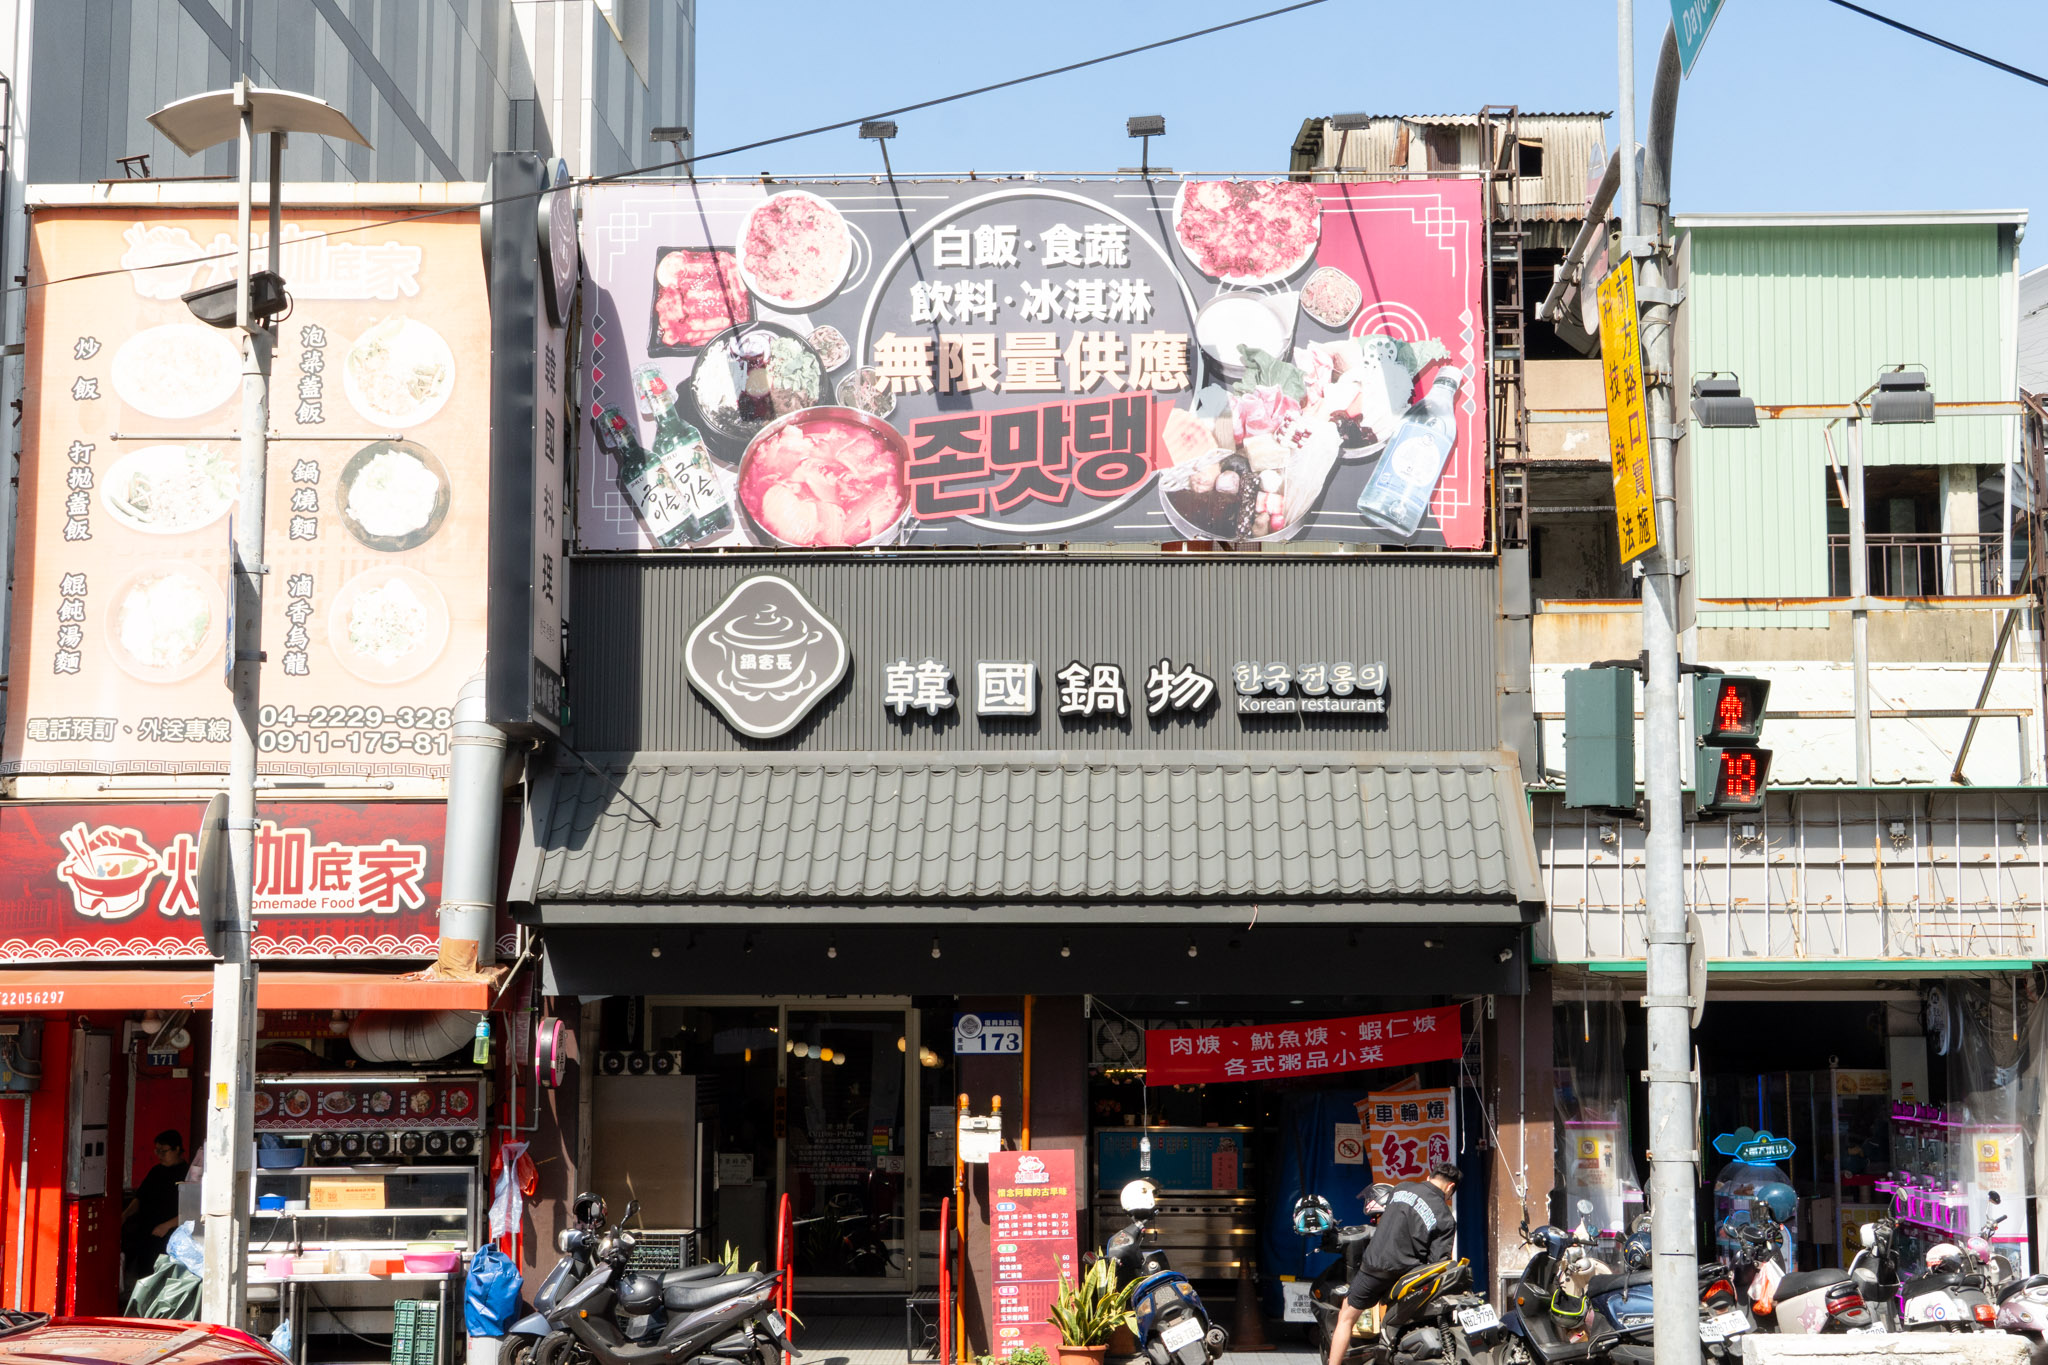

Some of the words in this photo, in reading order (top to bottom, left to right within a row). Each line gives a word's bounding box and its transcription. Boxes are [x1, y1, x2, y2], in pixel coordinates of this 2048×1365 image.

[910, 279, 1152, 322] 飲料·冰淇淋
[71, 336, 102, 401] 炒飯
[295, 324, 326, 424] 泡菜蓋飯
[873, 330, 1190, 393] 無限量供應
[1602, 283, 1635, 554] 科技執法
[1616, 271, 1651, 546] 前方路口實施
[904, 390, 1152, 520] 존맛탱
[289, 459, 320, 541] 鍋燒麵
[53, 572, 88, 675] 餛飩湯麵
[884, 657, 1217, 718] 韓國鍋物
[1234, 662, 1294, 694] 한국
[258, 705, 456, 730] 04-2229-328
[1239, 697, 1294, 712] Korean
[1301, 697, 1385, 713] restaurant
[258, 729, 454, 755] 0911-175-81
[251, 897, 317, 909] omemade
[321, 897, 355, 909] Food
[153, 1054, 174, 1066] 171
[977, 1033, 1020, 1051] 173
[1223, 1045, 1384, 1077] 各式粥品小菜
[1375, 1100, 1446, 1123] 車輪燒
[1382, 1133, 1424, 1177] 紅
[1413, 1197, 1437, 1232] TEAM
